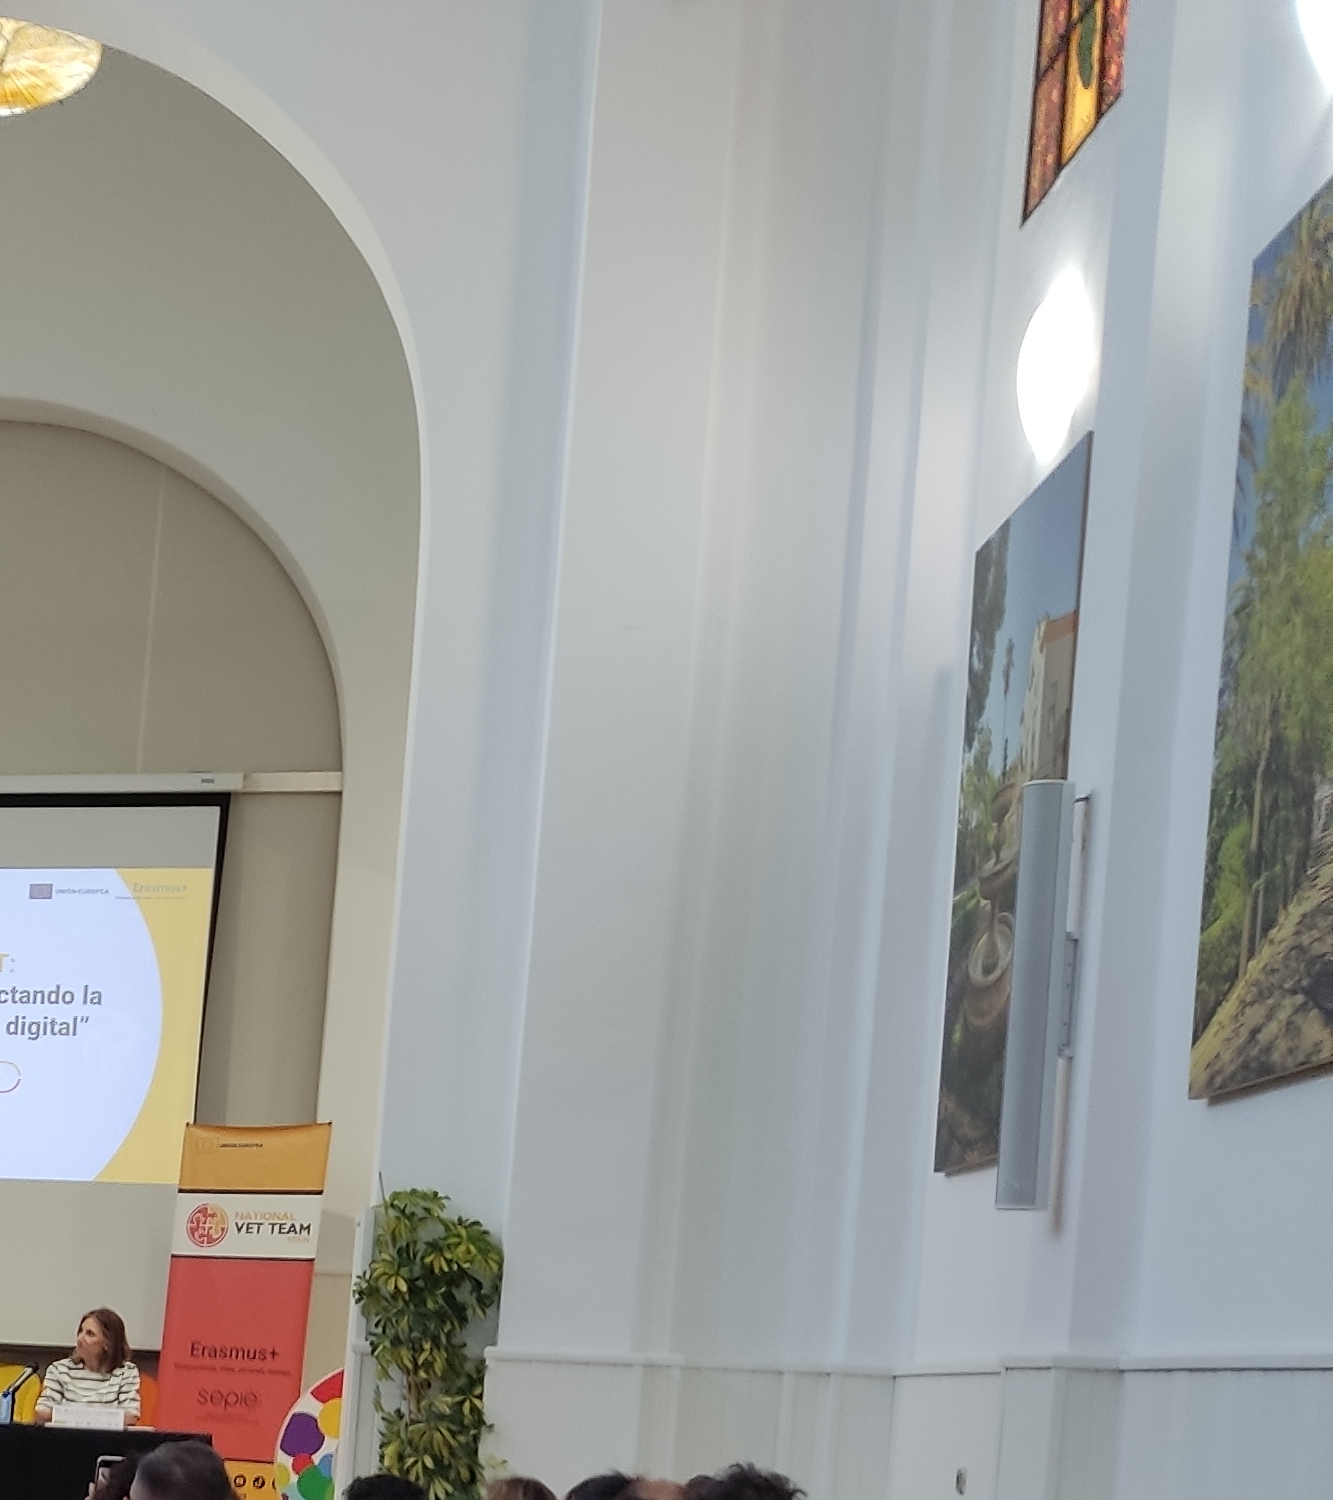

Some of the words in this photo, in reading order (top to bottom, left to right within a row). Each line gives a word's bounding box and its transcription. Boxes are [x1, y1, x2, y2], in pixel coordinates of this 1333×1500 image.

[82, 984, 103, 1006] la
[234, 1211, 297, 1221] NATIONAL
[234, 1221, 265, 1235] VET
[268, 1222, 311, 1236] TEAM
[190, 1341, 279, 1362] Erasmus+
